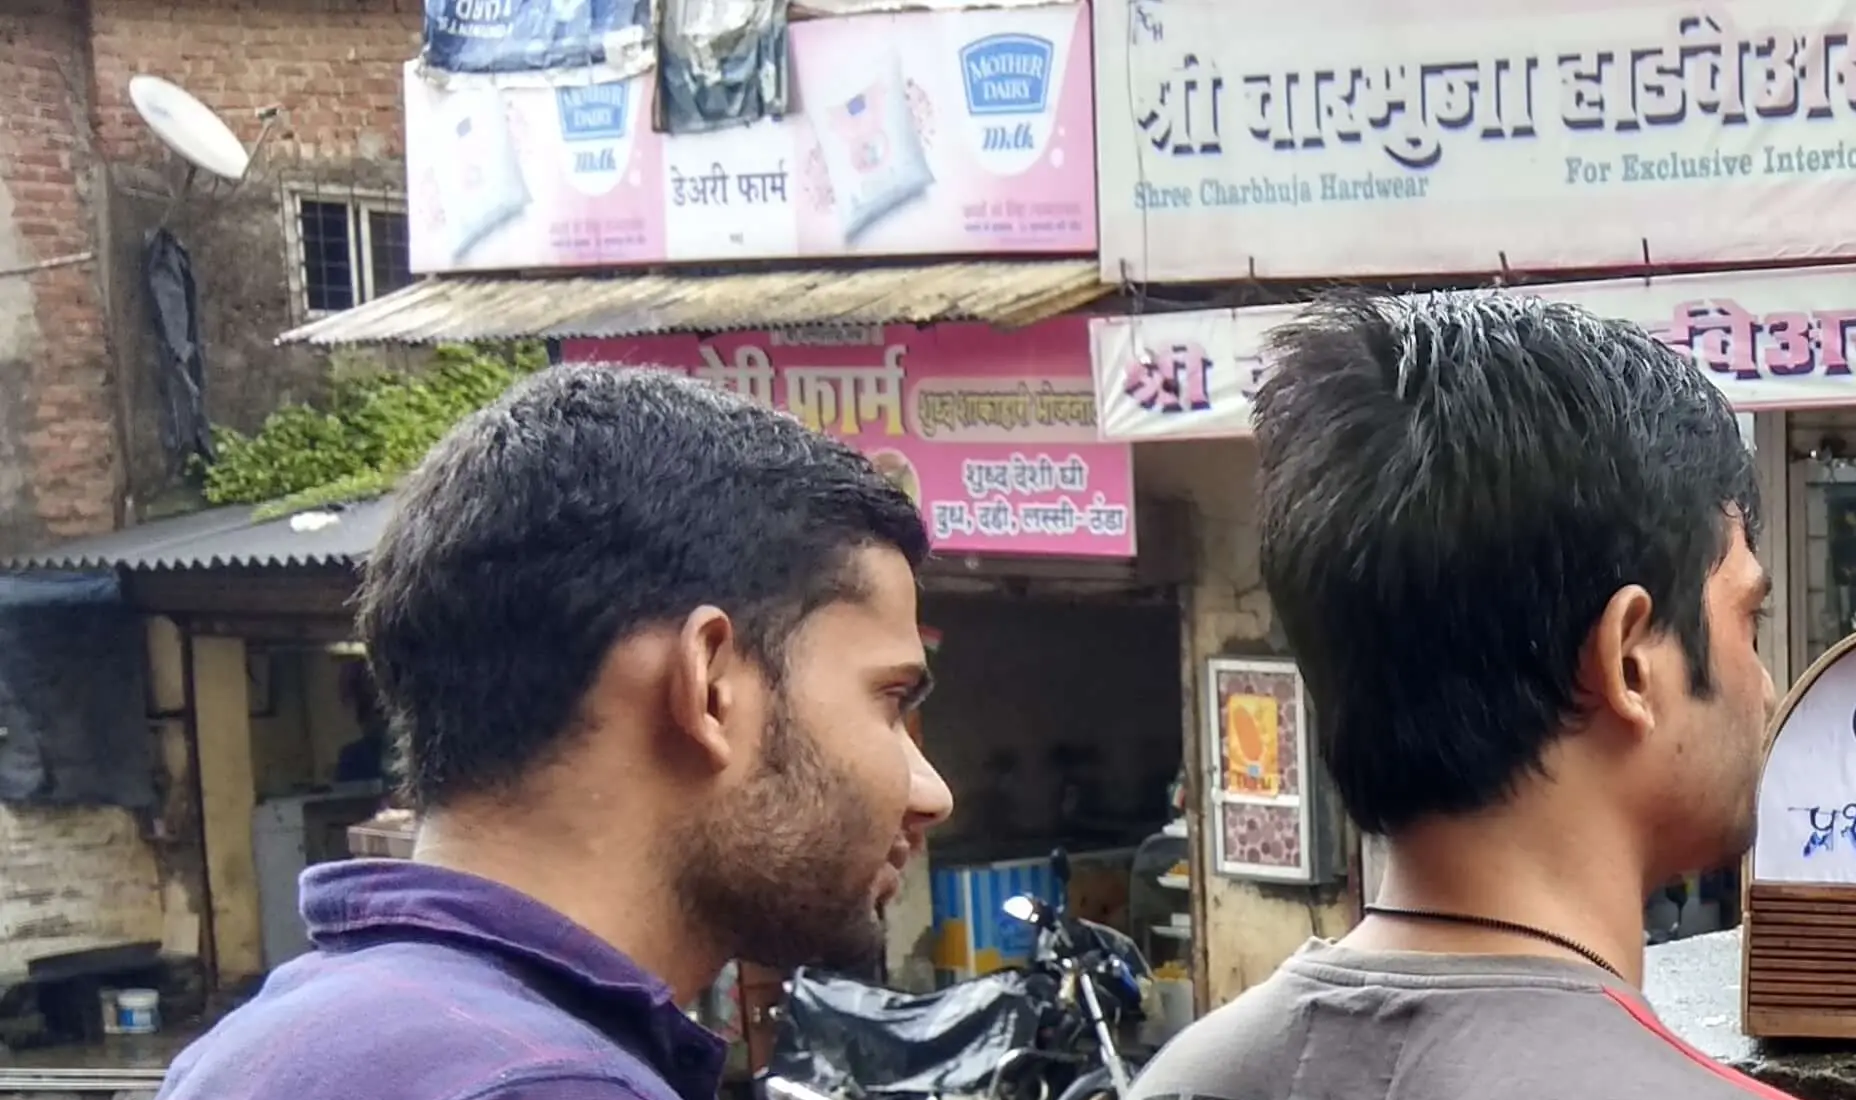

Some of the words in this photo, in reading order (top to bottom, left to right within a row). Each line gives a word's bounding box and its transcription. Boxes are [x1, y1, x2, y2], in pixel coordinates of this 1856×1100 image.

[970, 53, 1043, 84] MOTHER
[1134, 50, 1223, 155] श्री
[736, 158, 789, 204] फार्म
[1564, 156, 1611, 185] For
[1621, 149, 1752, 182] Exclusive
[1133, 179, 1192, 209] Shree
[1199, 173, 1312, 208] Charbhuja
[1319, 170, 1430, 201] Hardwear
[783, 342, 909, 435] फार्म
[1124, 339, 1213, 413] श्री
[1014, 456, 1054, 493] देशी
[1059, 458, 1086, 487] घी
